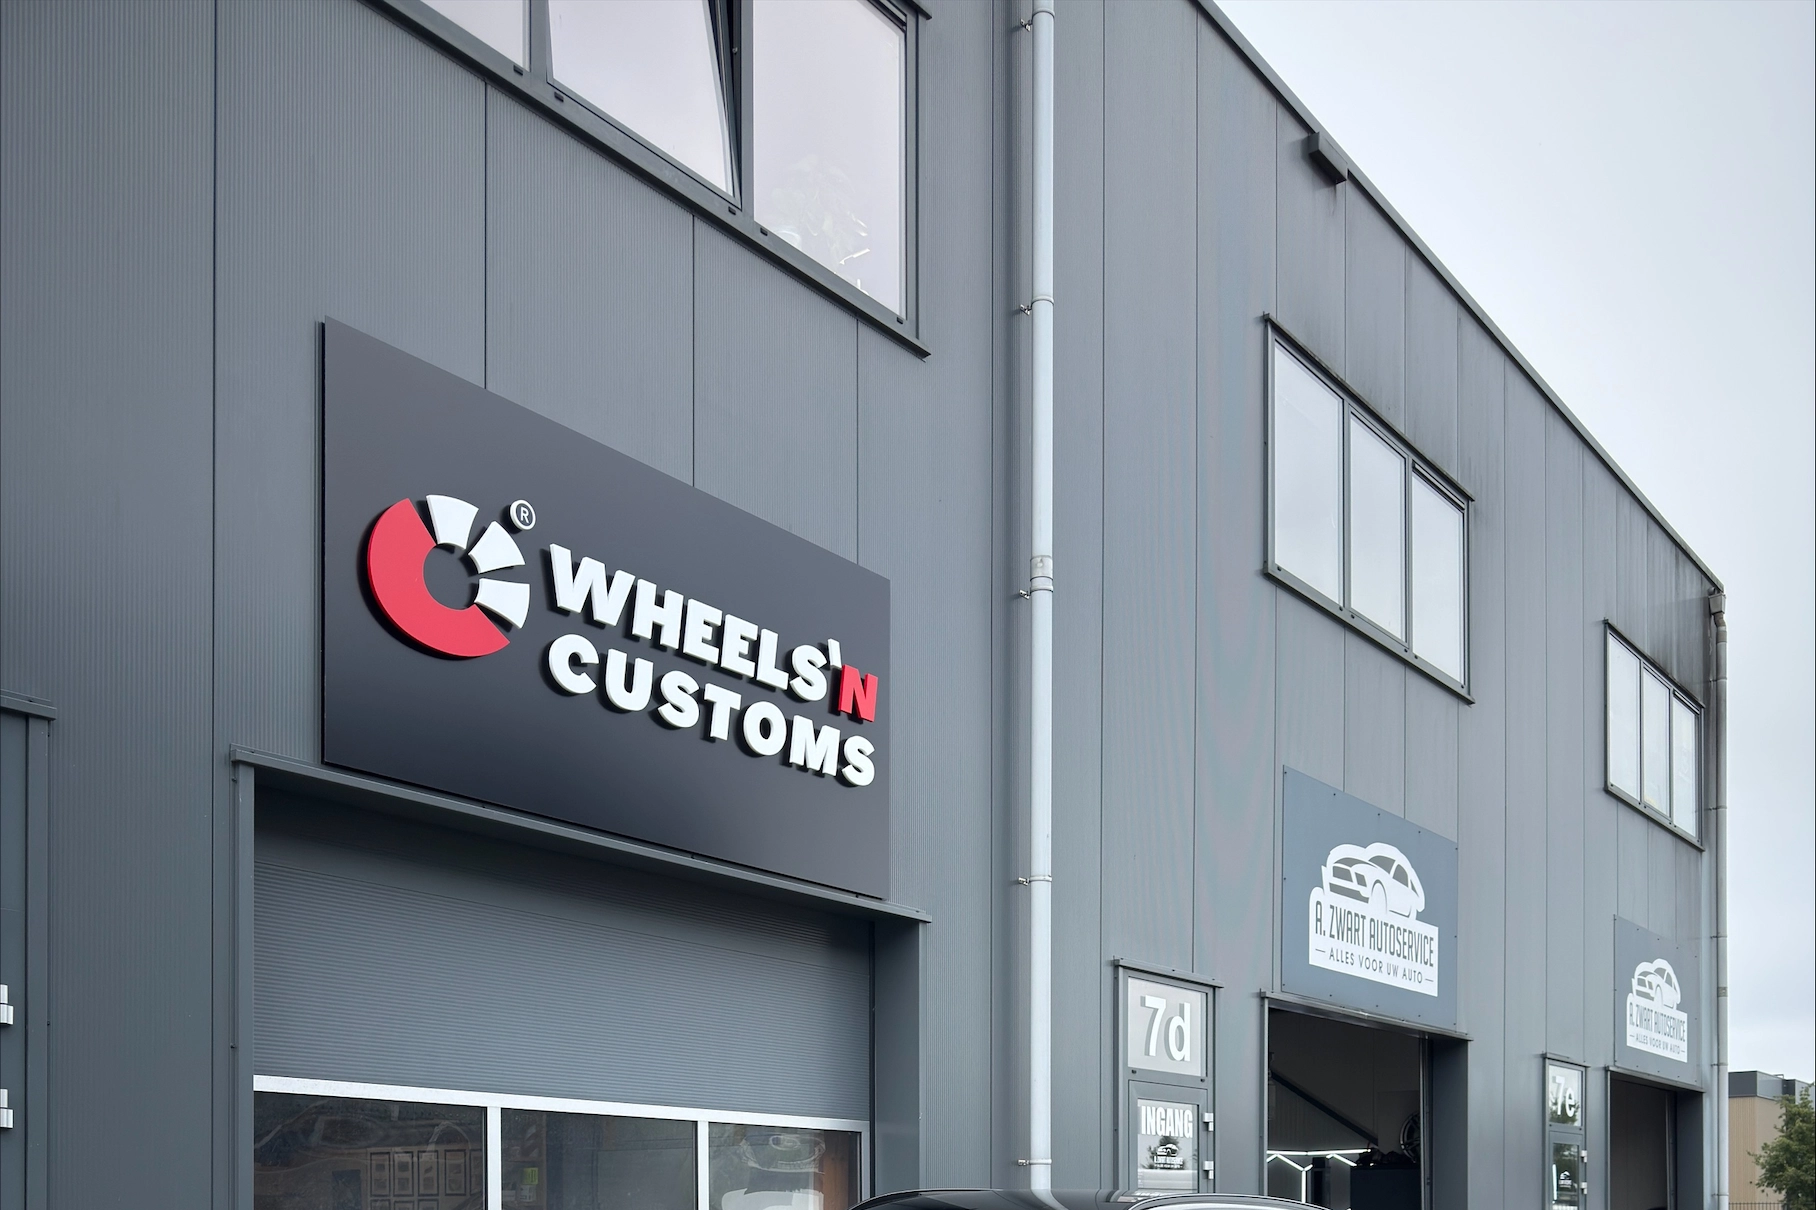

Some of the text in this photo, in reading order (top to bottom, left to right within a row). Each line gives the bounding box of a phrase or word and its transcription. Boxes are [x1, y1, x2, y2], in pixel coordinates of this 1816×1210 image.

[548, 634, 875, 786] CUSTOMS
[1315, 900, 1434, 967] A. ZWART AUTOSERVICE
[1329, 947, 1423, 984] ALLES VOOR UW AUTO
[1141, 995, 1191, 1062] 7d
[1636, 1004, 1653, 1032] ZWART
[1654, 1011, 1685, 1042] AUTOSERVICE
[1636, 1033, 1648, 1045] ALLES
[1554, 1075, 1575, 1117] 7e
[1141, 1105, 1193, 1139] INGANG
